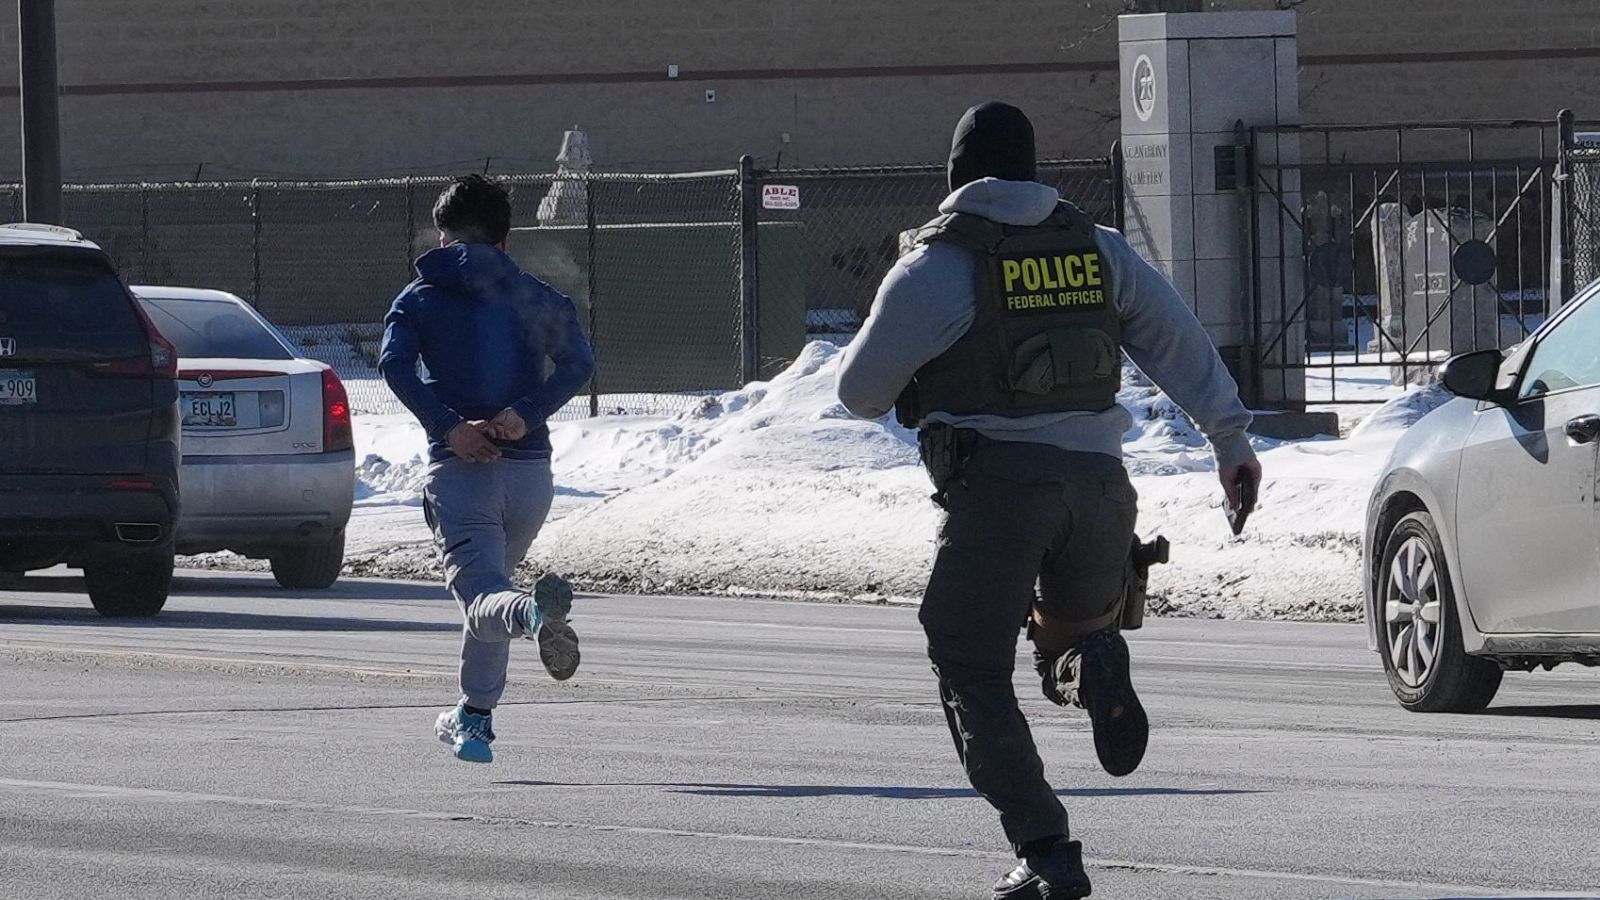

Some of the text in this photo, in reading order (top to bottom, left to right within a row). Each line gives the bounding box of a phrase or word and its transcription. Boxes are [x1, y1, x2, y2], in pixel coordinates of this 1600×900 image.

[765, 188, 796, 196] ABLE
[1003, 254, 1101, 291] POLICE
[1008, 290, 1104, 309] FEDERAL OFFICER
[7, 379, 33, 397] 909
